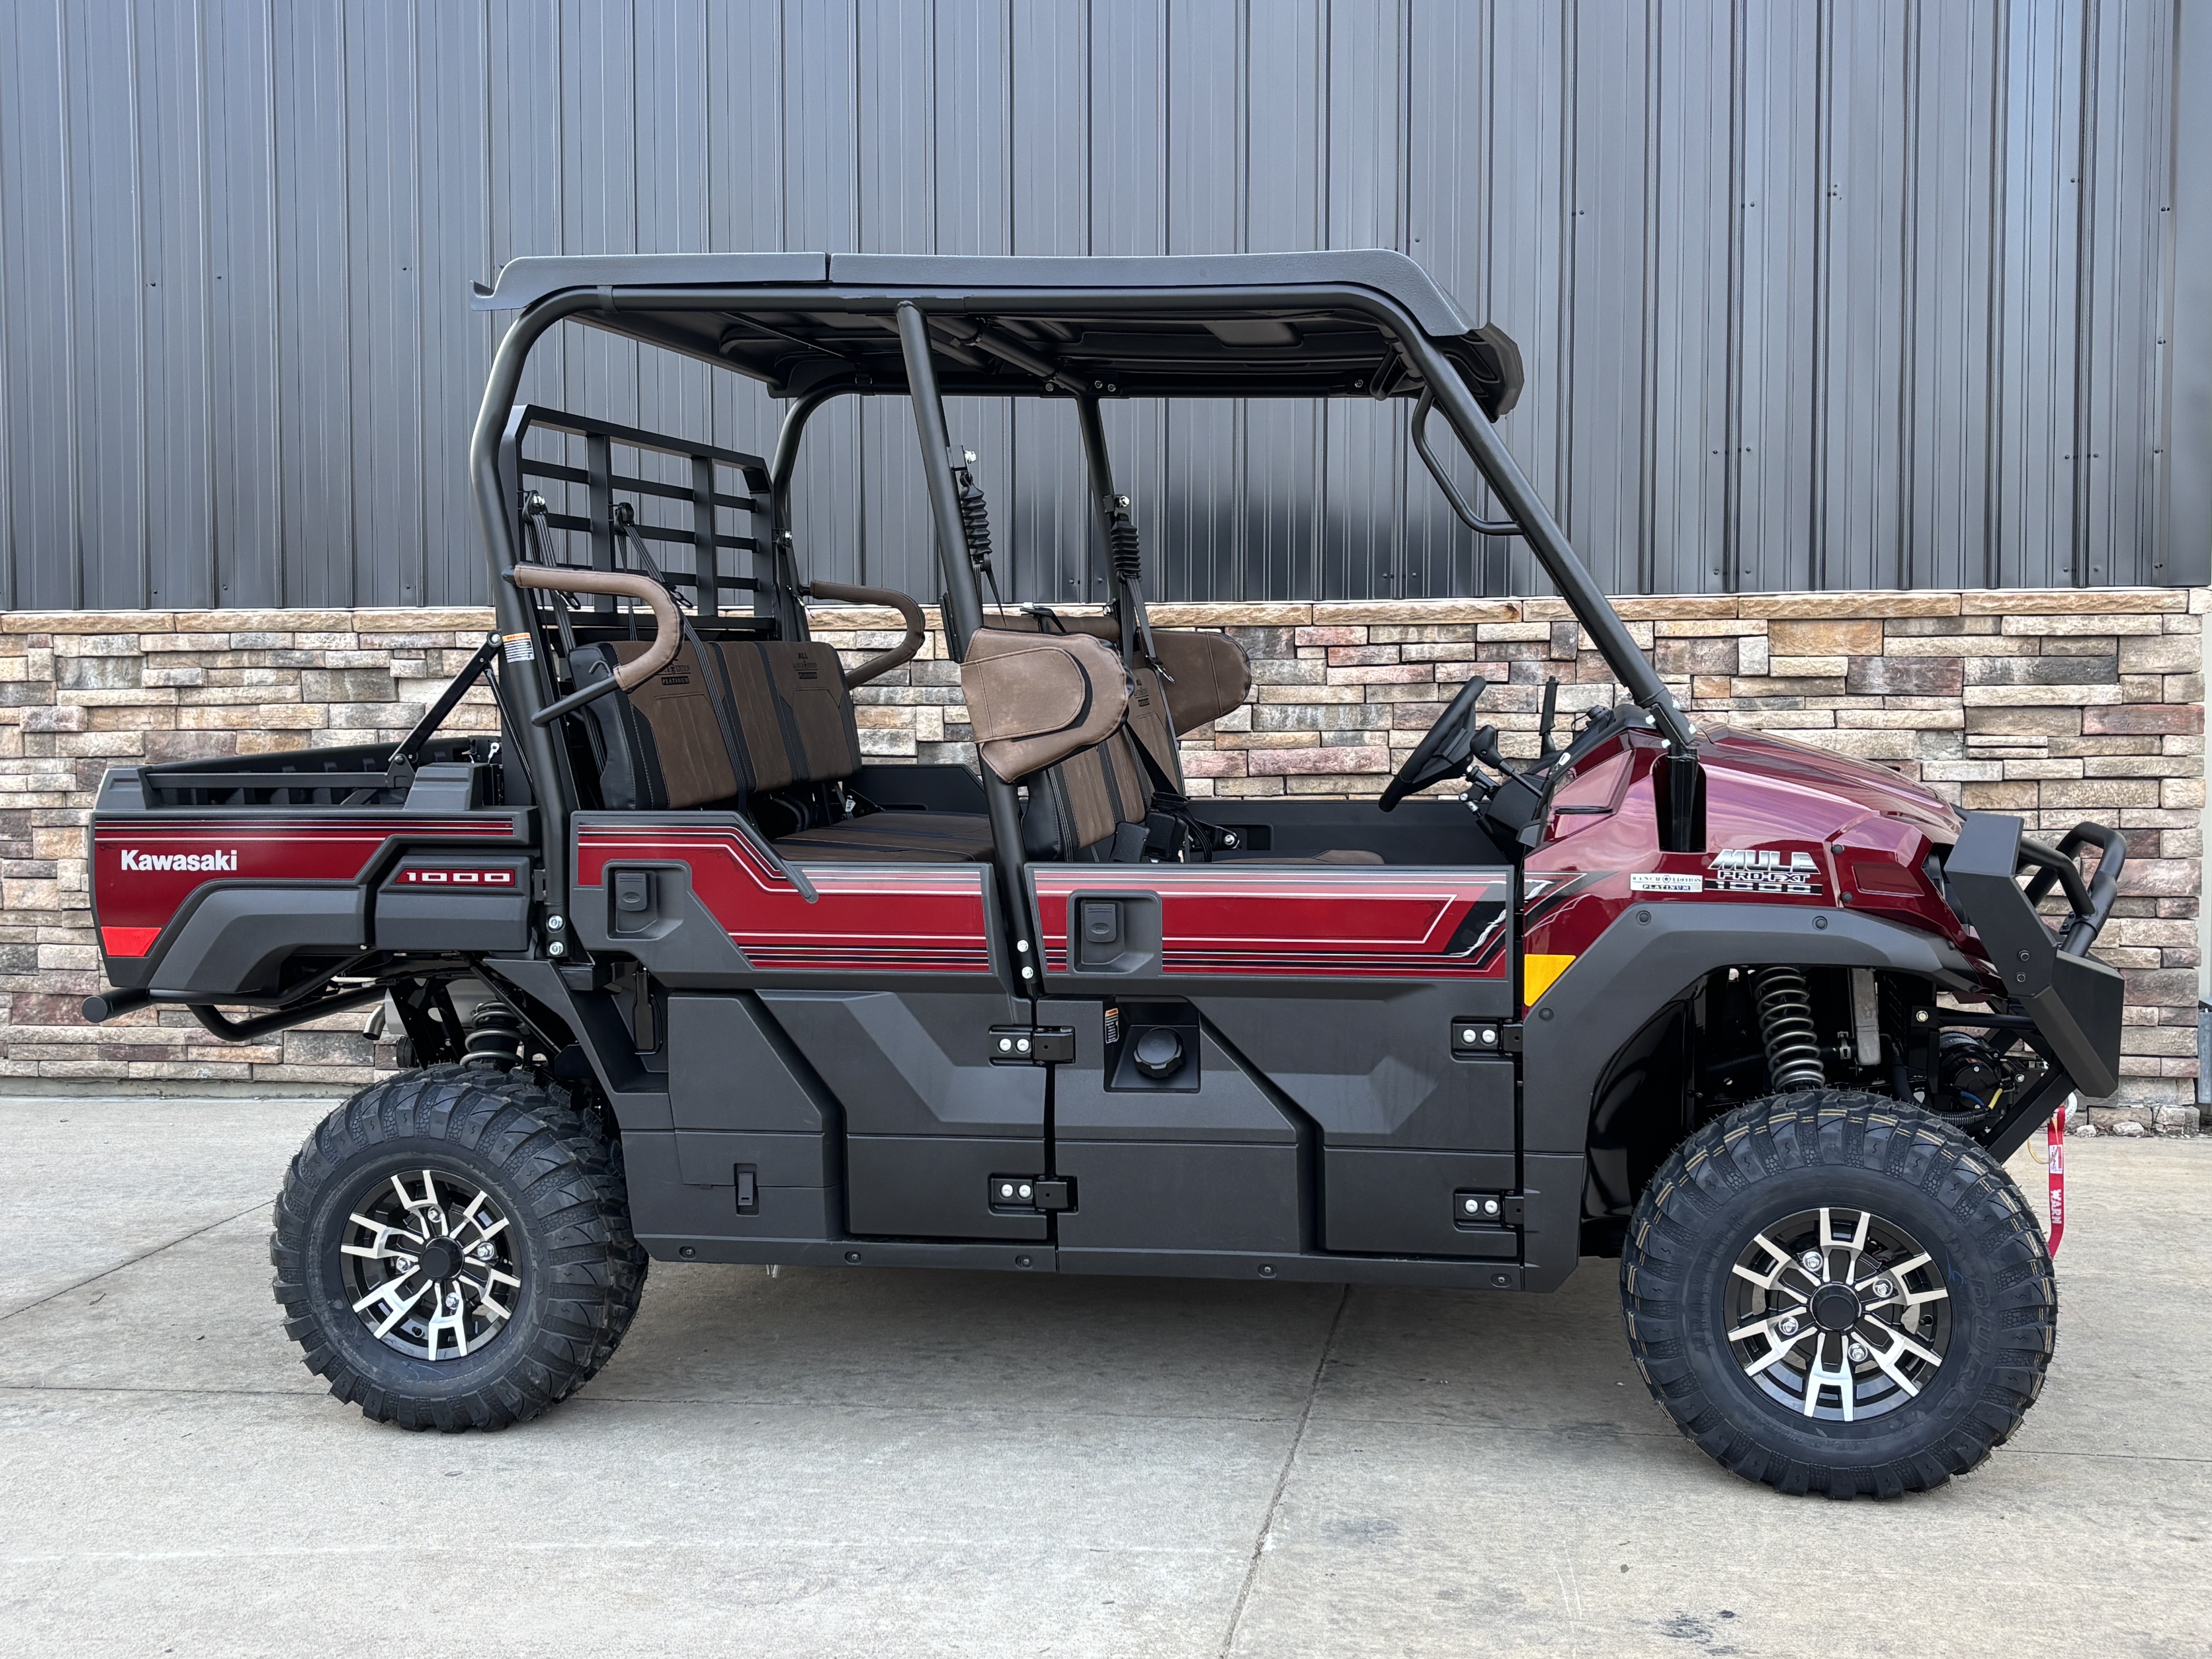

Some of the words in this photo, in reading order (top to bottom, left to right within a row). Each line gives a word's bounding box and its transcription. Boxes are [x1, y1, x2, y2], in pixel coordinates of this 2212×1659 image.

[121, 850, 237, 871] Kawasaki
[1707, 849, 1821, 874] MULE
[407, 872, 510, 881] 1000
[1716, 881, 1811, 893] 1000
[2050, 1189, 2062, 1224] WARN
